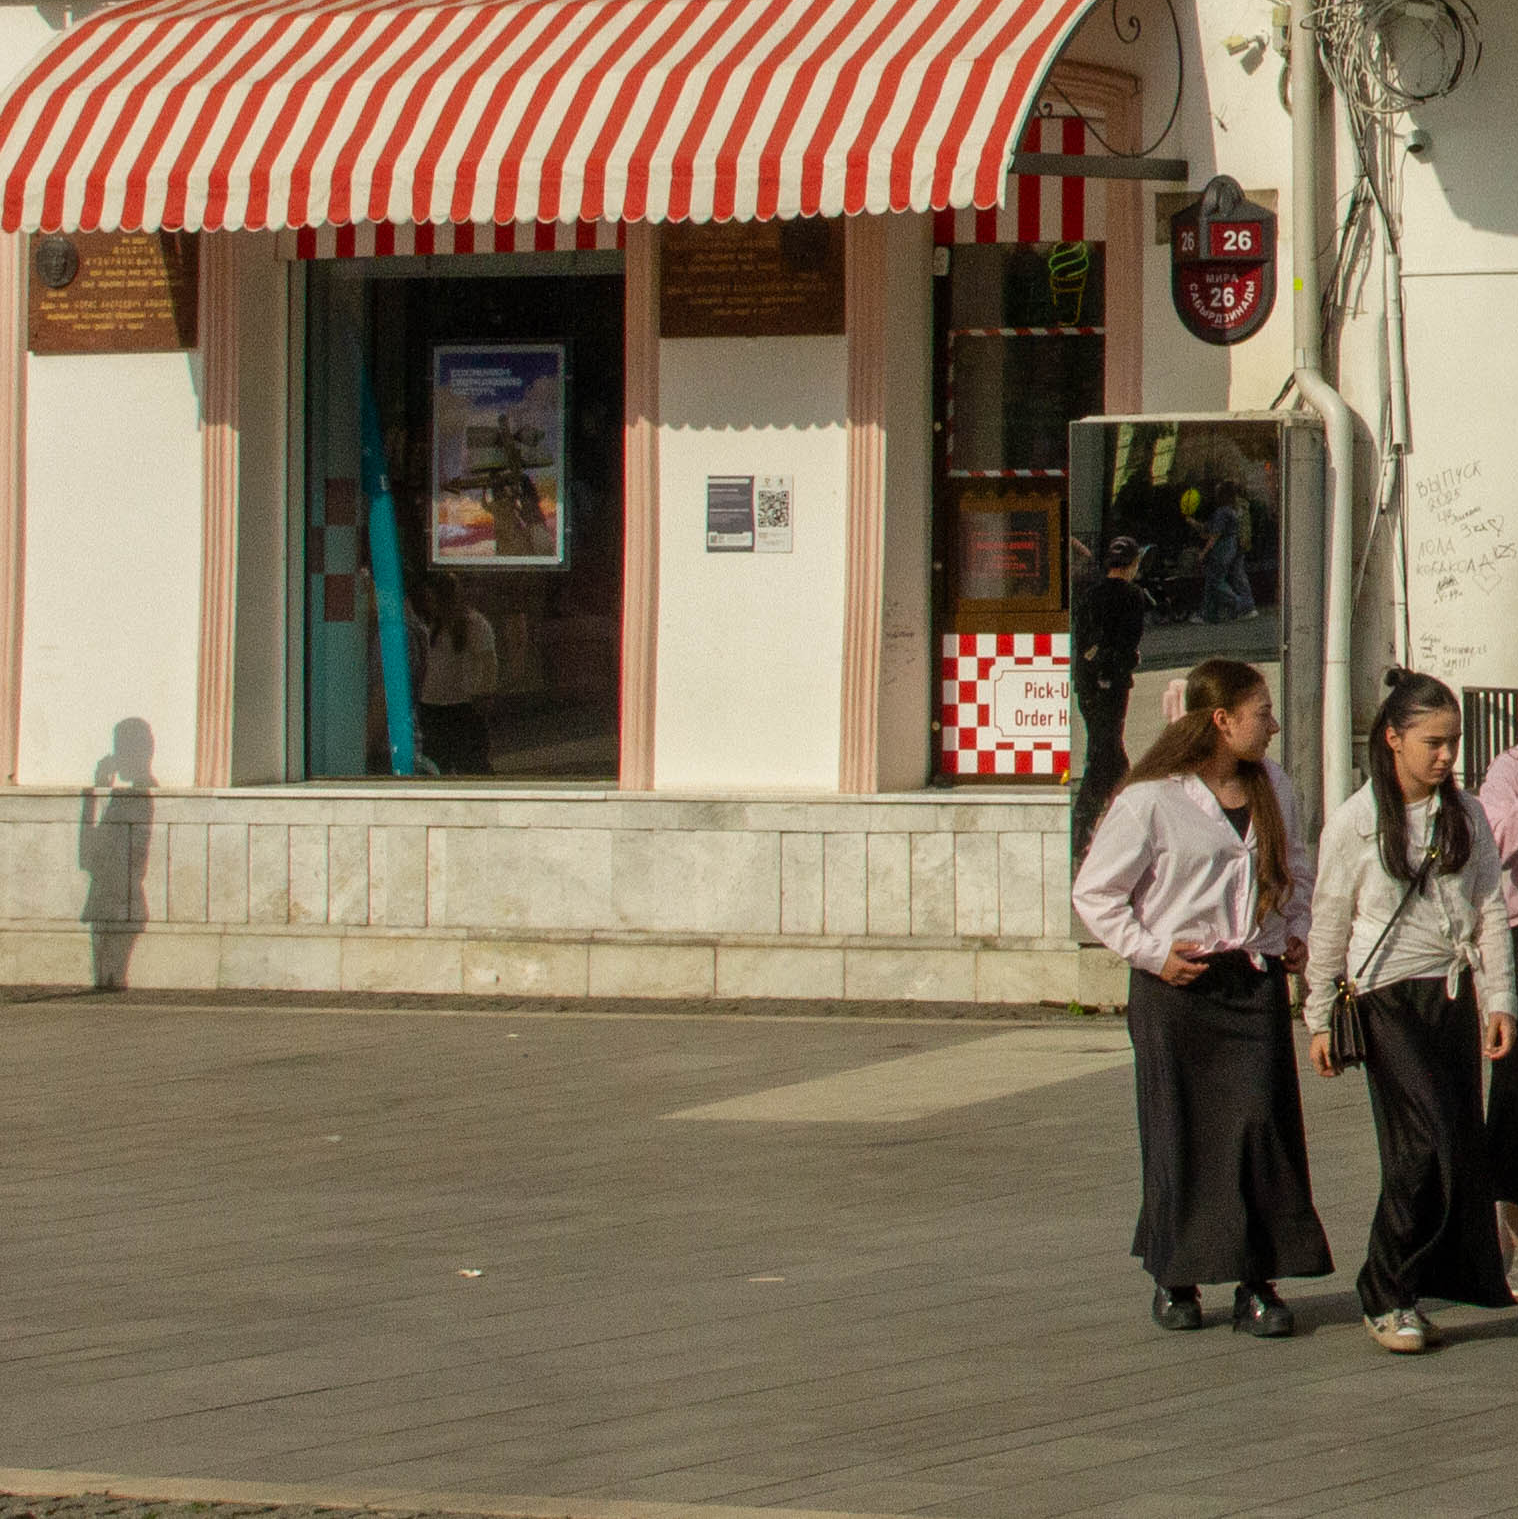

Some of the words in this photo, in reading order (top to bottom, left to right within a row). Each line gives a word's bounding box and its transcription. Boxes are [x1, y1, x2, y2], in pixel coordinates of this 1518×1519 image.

[1181, 231, 1195, 251] 26
[1223, 230, 1252, 251] 26
[1205, 273, 1239, 283] МИРА
[1210, 286, 1235, 307] 26
[1025, 681, 1070, 699] Pick-U
[1015, 709, 1053, 727] Order
[1059, 709, 1071, 727] H
